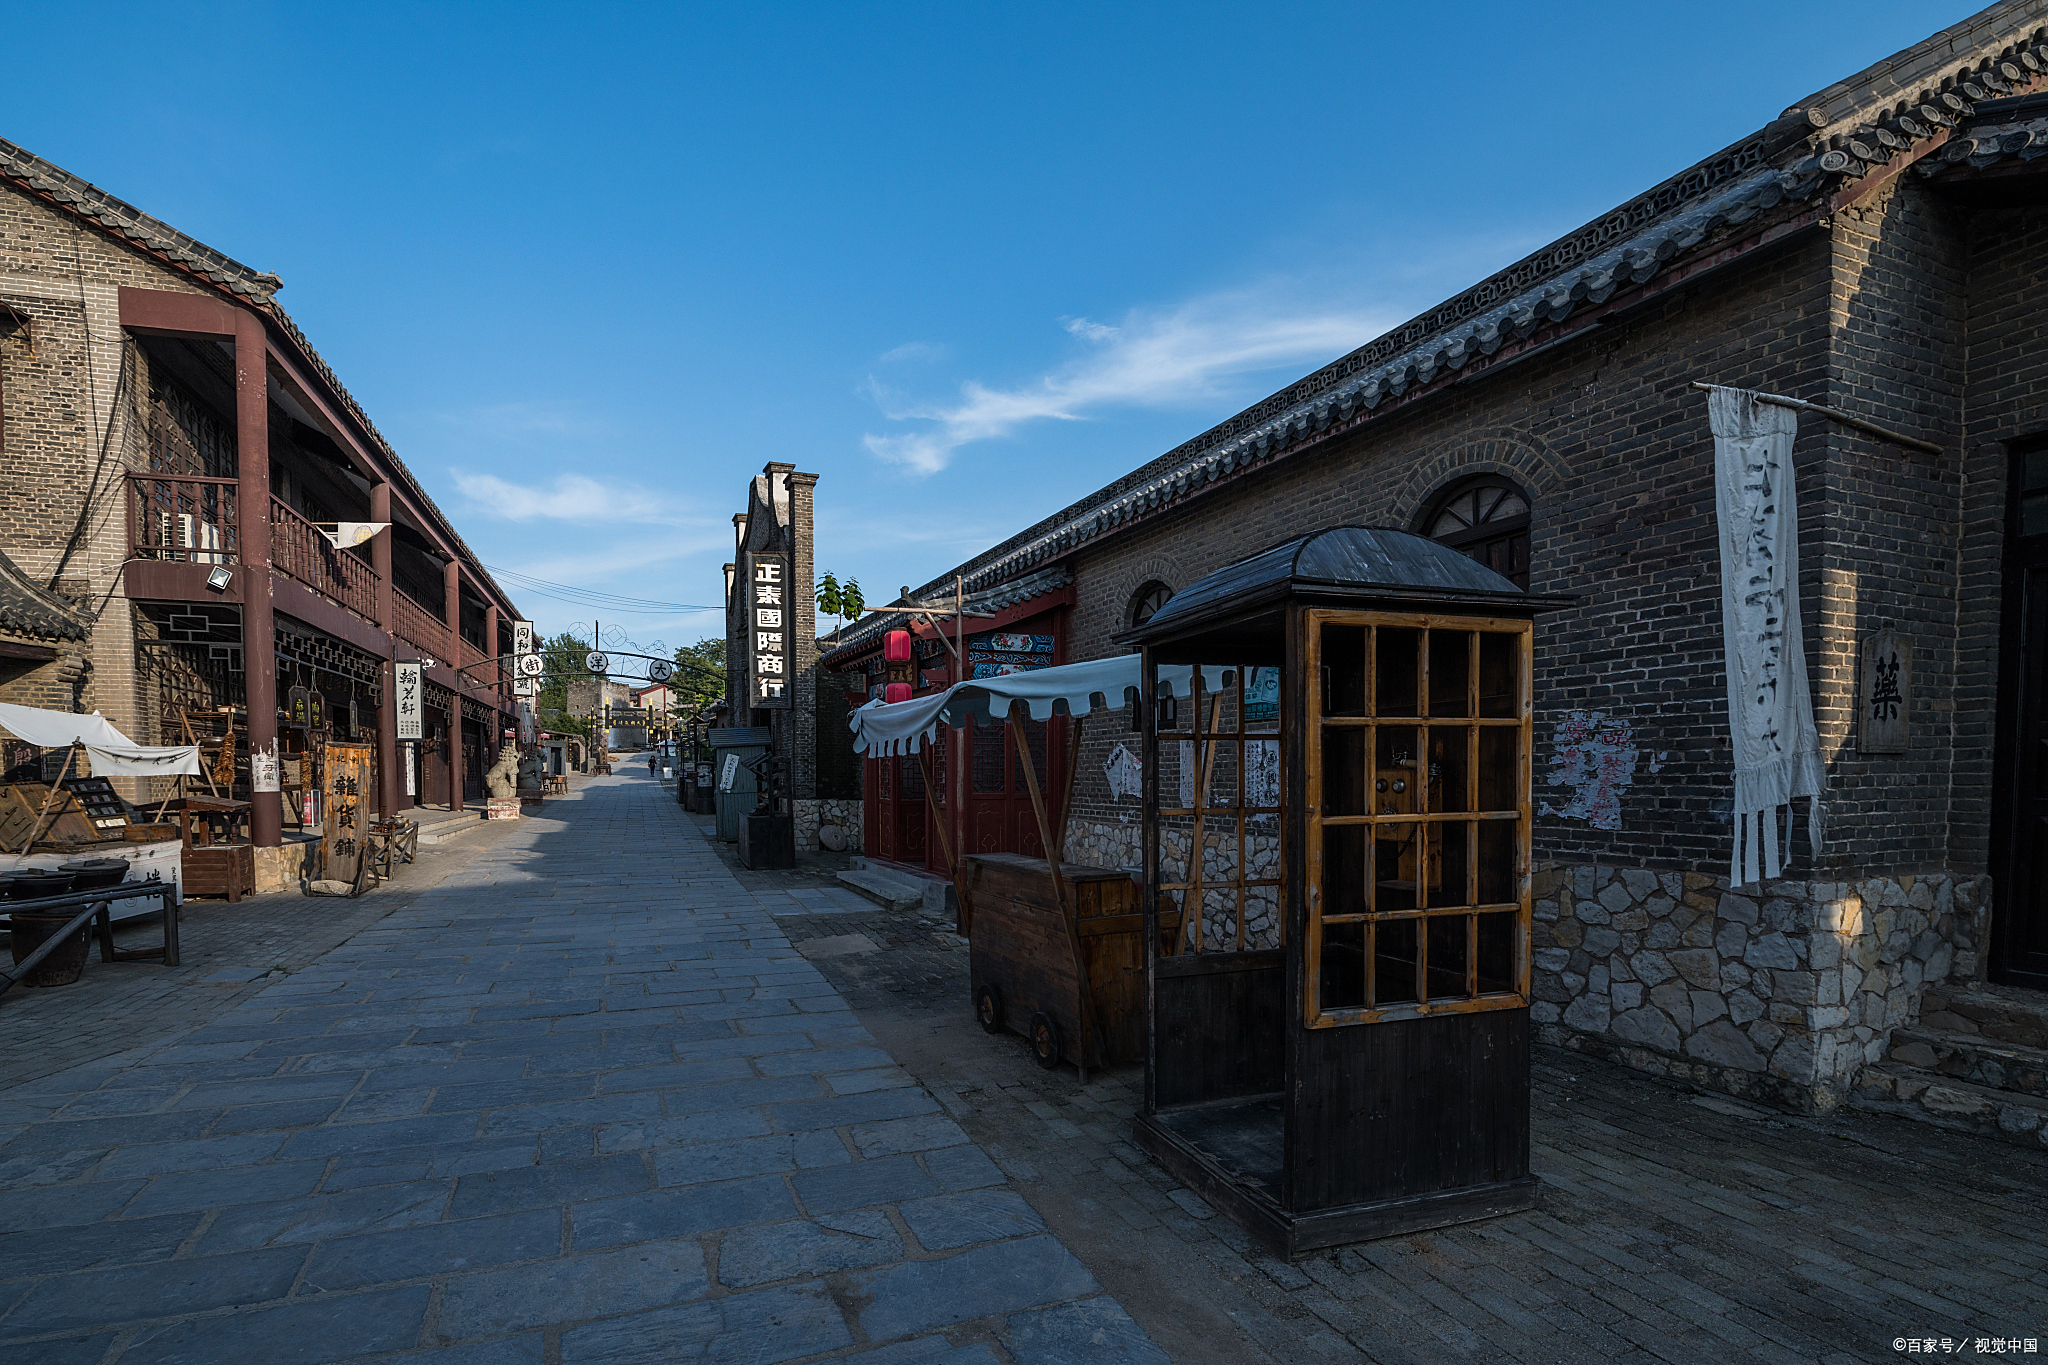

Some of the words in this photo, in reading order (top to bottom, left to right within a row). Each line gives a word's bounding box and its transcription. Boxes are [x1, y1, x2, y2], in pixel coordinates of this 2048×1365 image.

[755, 563, 784, 697] 正泰國際商行
[1870, 651, 1903, 722] 藥
